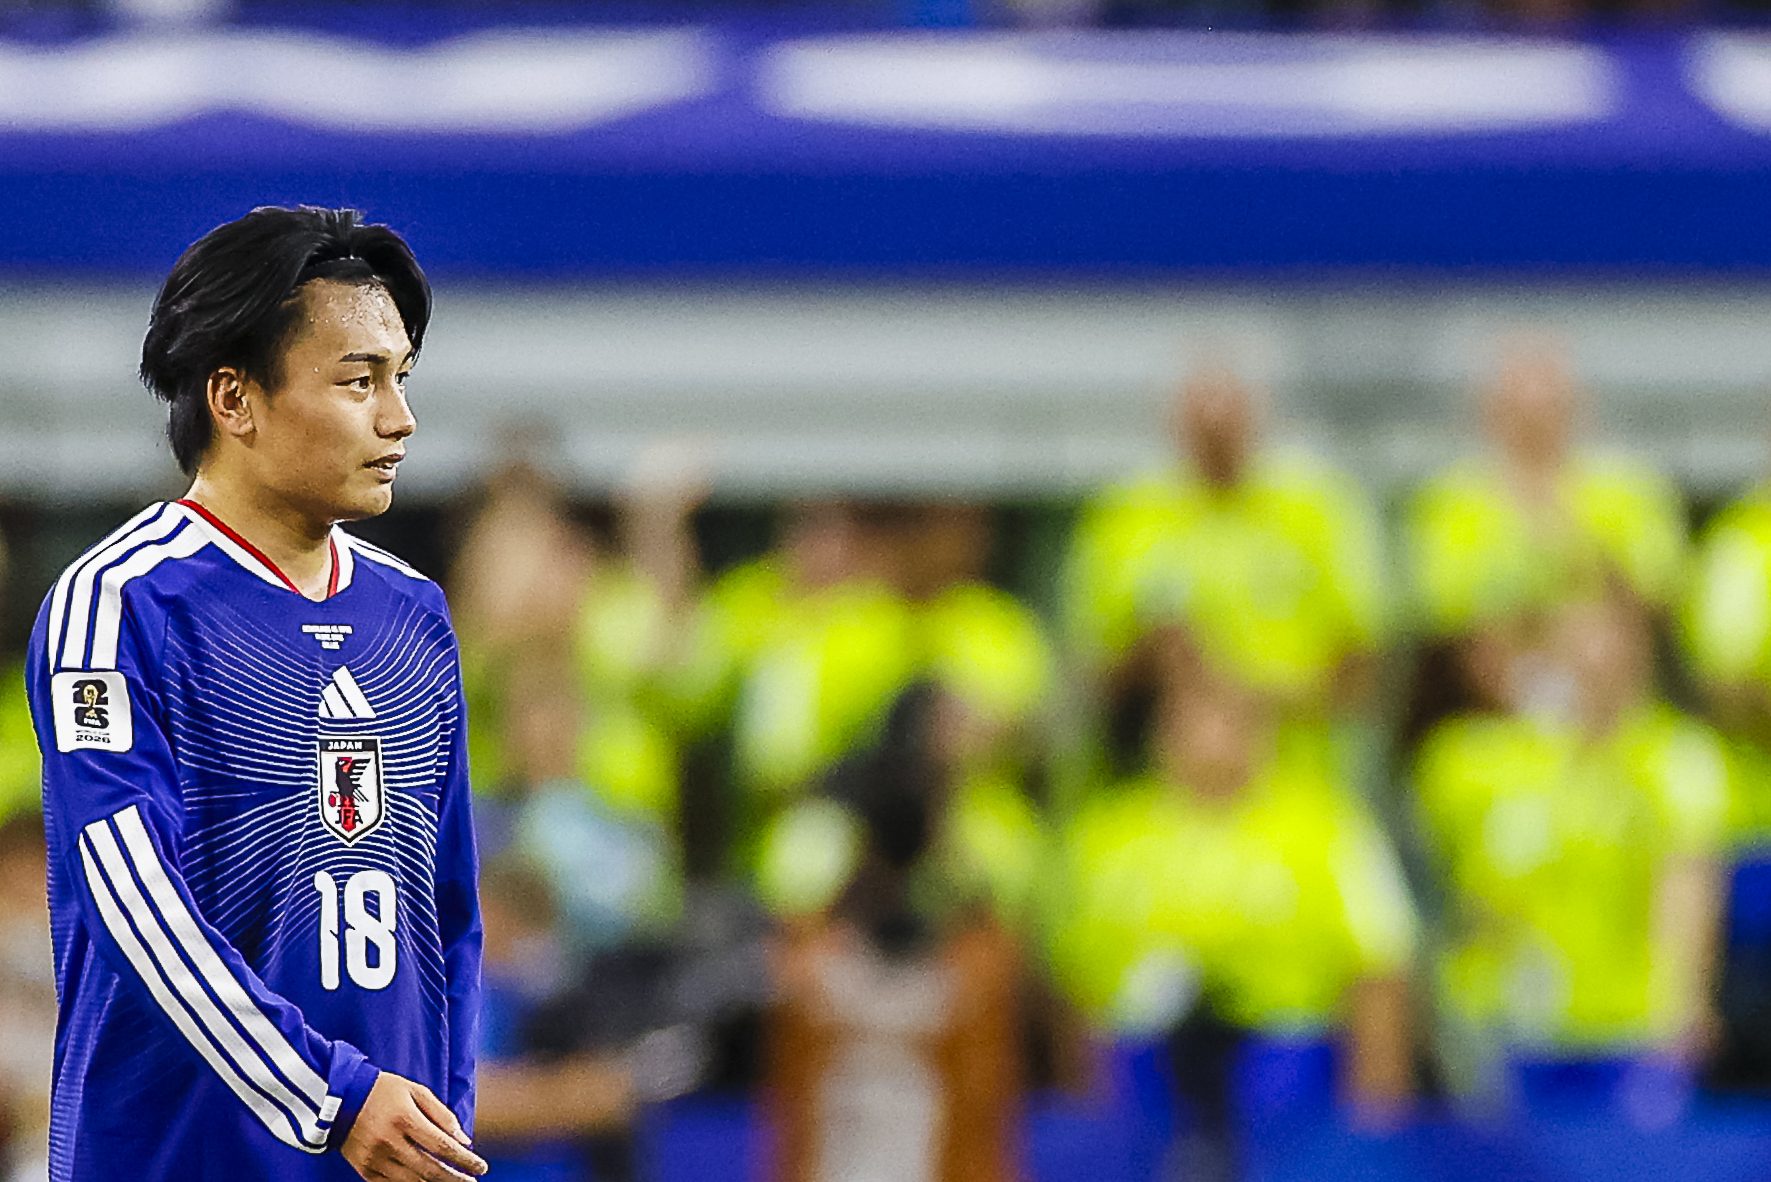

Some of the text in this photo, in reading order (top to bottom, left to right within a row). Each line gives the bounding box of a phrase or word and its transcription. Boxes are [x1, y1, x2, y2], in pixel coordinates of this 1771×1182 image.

[75, 735, 111, 743] 2026
[328, 741, 363, 751] JAPAN
[314, 869, 397, 990] 18
